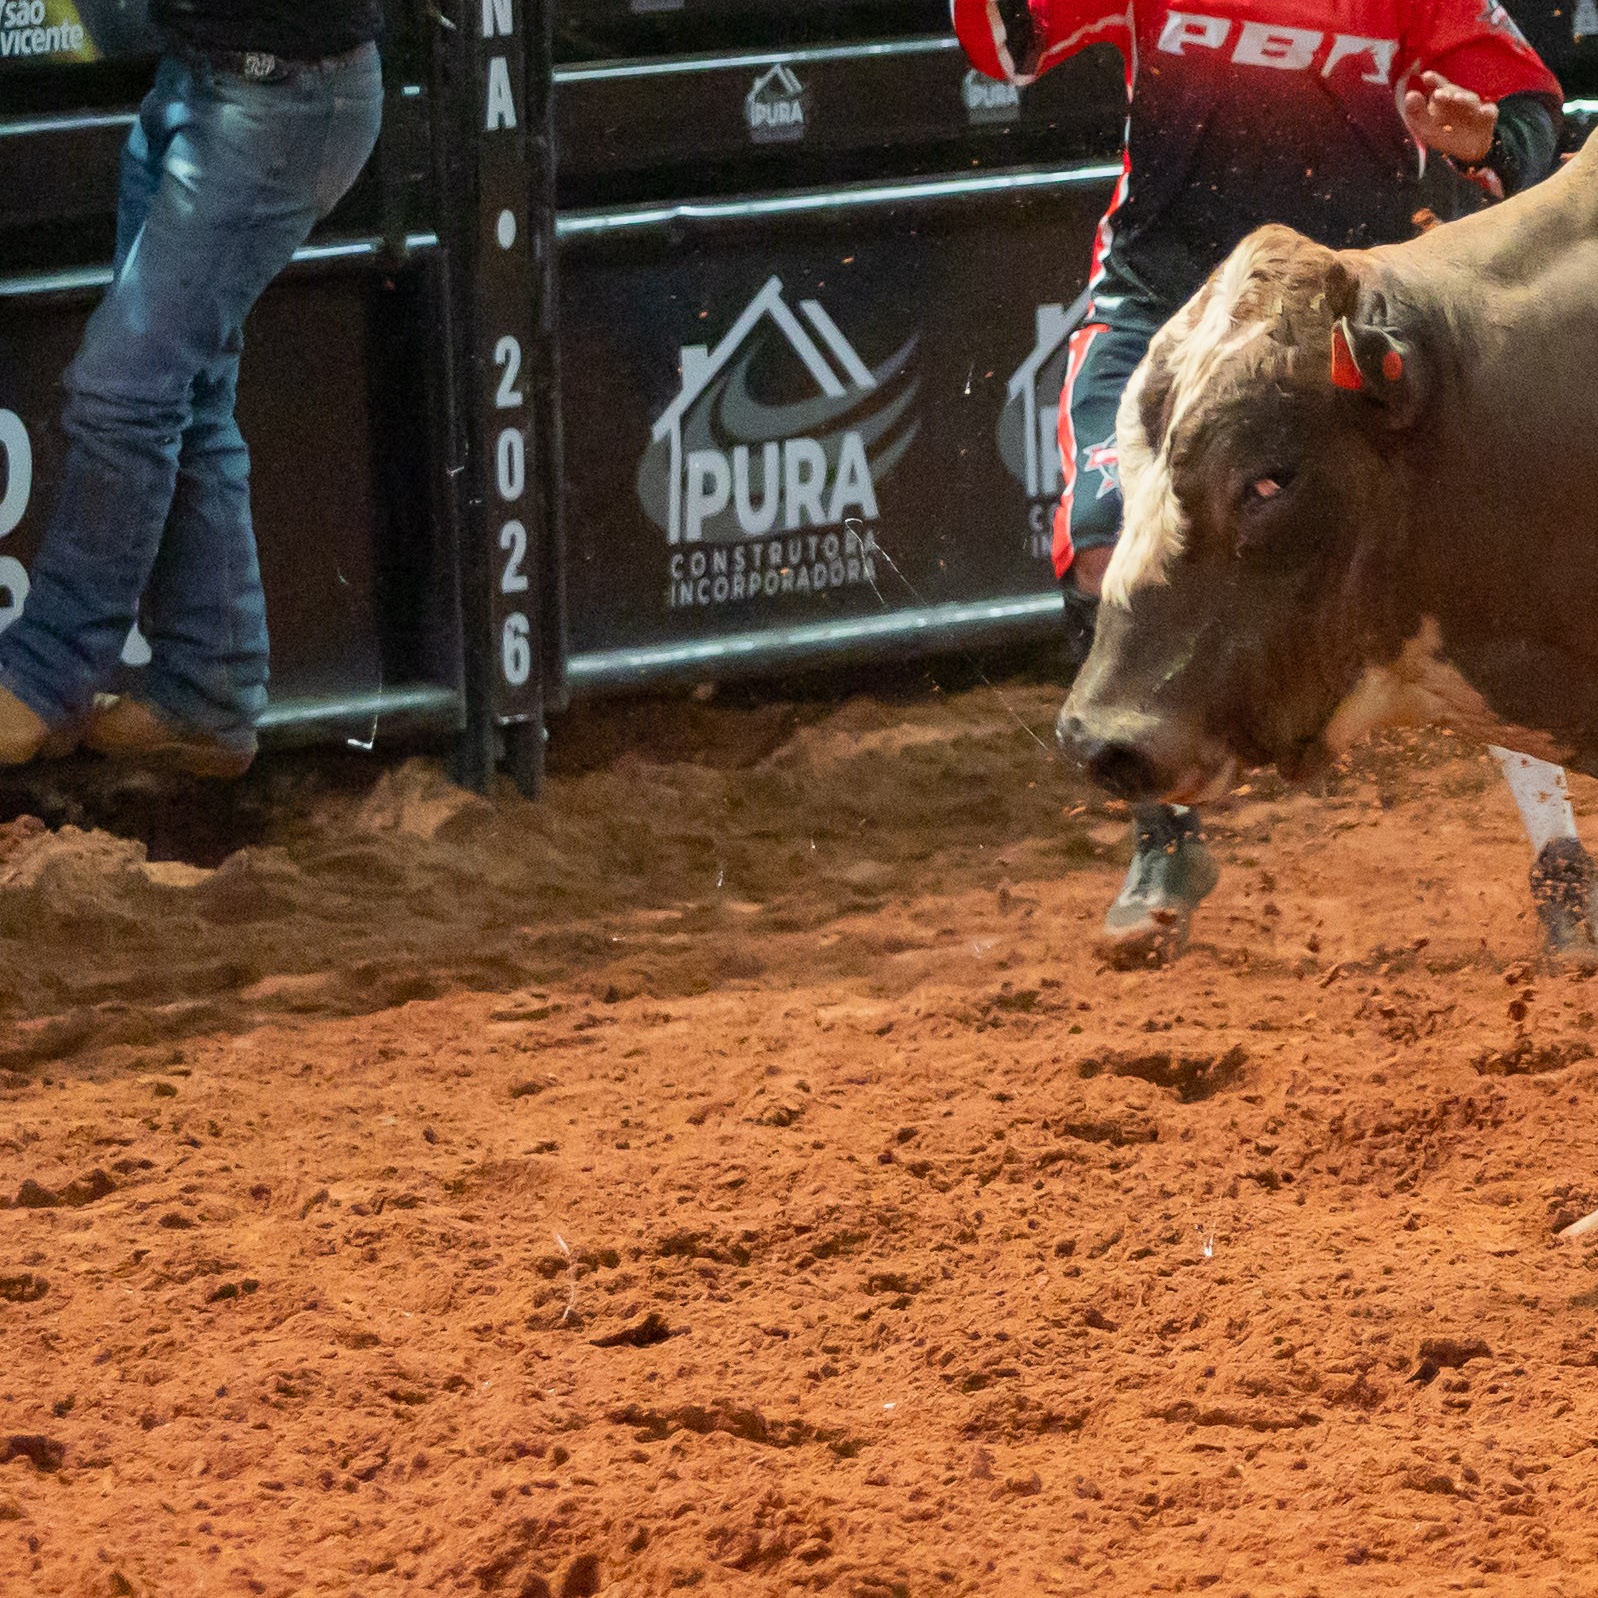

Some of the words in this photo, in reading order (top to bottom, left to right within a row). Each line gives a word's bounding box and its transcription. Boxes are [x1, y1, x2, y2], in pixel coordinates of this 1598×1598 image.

[1156, 9, 1399, 85] PBR
[493, 334, 533, 687] 2026
[684, 431, 881, 544] PURA
[670, 528, 878, 580] CONSTRUTORA
